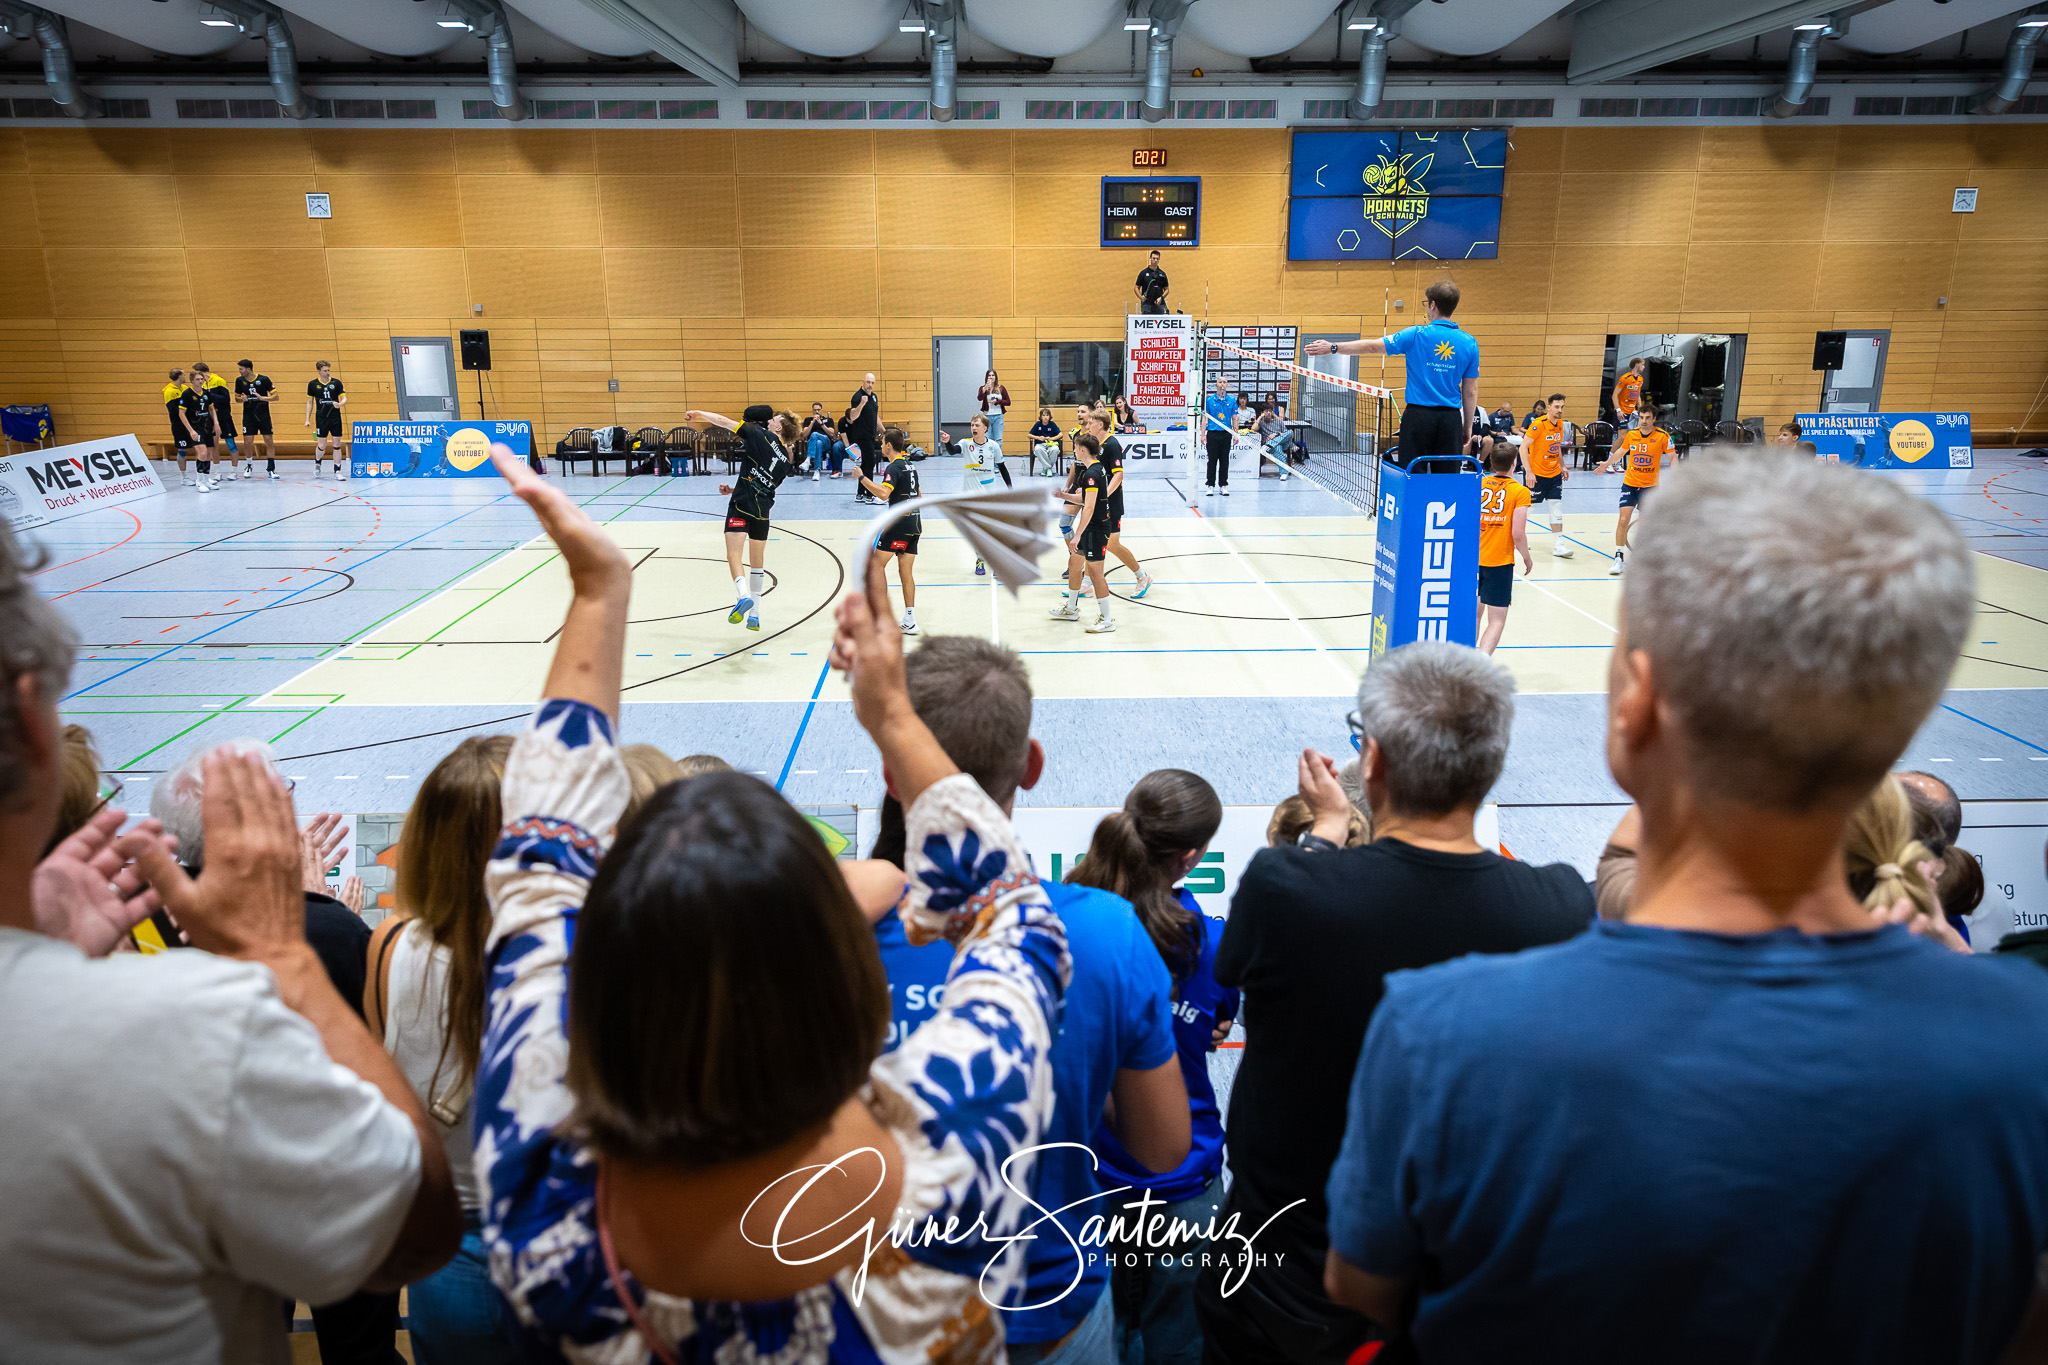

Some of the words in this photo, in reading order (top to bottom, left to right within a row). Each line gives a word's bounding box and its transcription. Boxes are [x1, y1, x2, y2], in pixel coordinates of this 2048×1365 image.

[1107, 207, 1137, 216] HEIM
[1164, 206, 1194, 216] GAST
[1366, 199, 1425, 215] HORNETS
[1134, 319, 1186, 329] MEYSEL
[1142, 338, 1176, 348] SCHILDER
[1134, 350, 1182, 360] FOTOTAPETEN
[1140, 362, 1178, 372] SCHRIFTEN
[1136, 374, 1181, 384] KLEBEFOLIEN
[1139, 385, 1179, 395] FAHRZEUG-
[1133, 395, 1185, 405] BESCHRIFTUNG
[1798, 417, 1816, 428] DYN
[1819, 416, 1880, 428] PRÄSENTIERT
[354, 425, 373, 436] DYN
[376, 424, 438, 436] PRÄSENTIERT
[1122, 444, 1174, 460] YSEL
[1639, 444, 1647, 453] 13
[978, 455, 984, 464] 3
[25, 448, 147, 494] MEYSEL
[45, 492, 80, 510] Druck
[80, 492, 86, 500] +
[86, 476, 154, 500] Werbetechnik
[1481, 487, 1506, 514] 23
[1417, 501, 1456, 642] EMER
